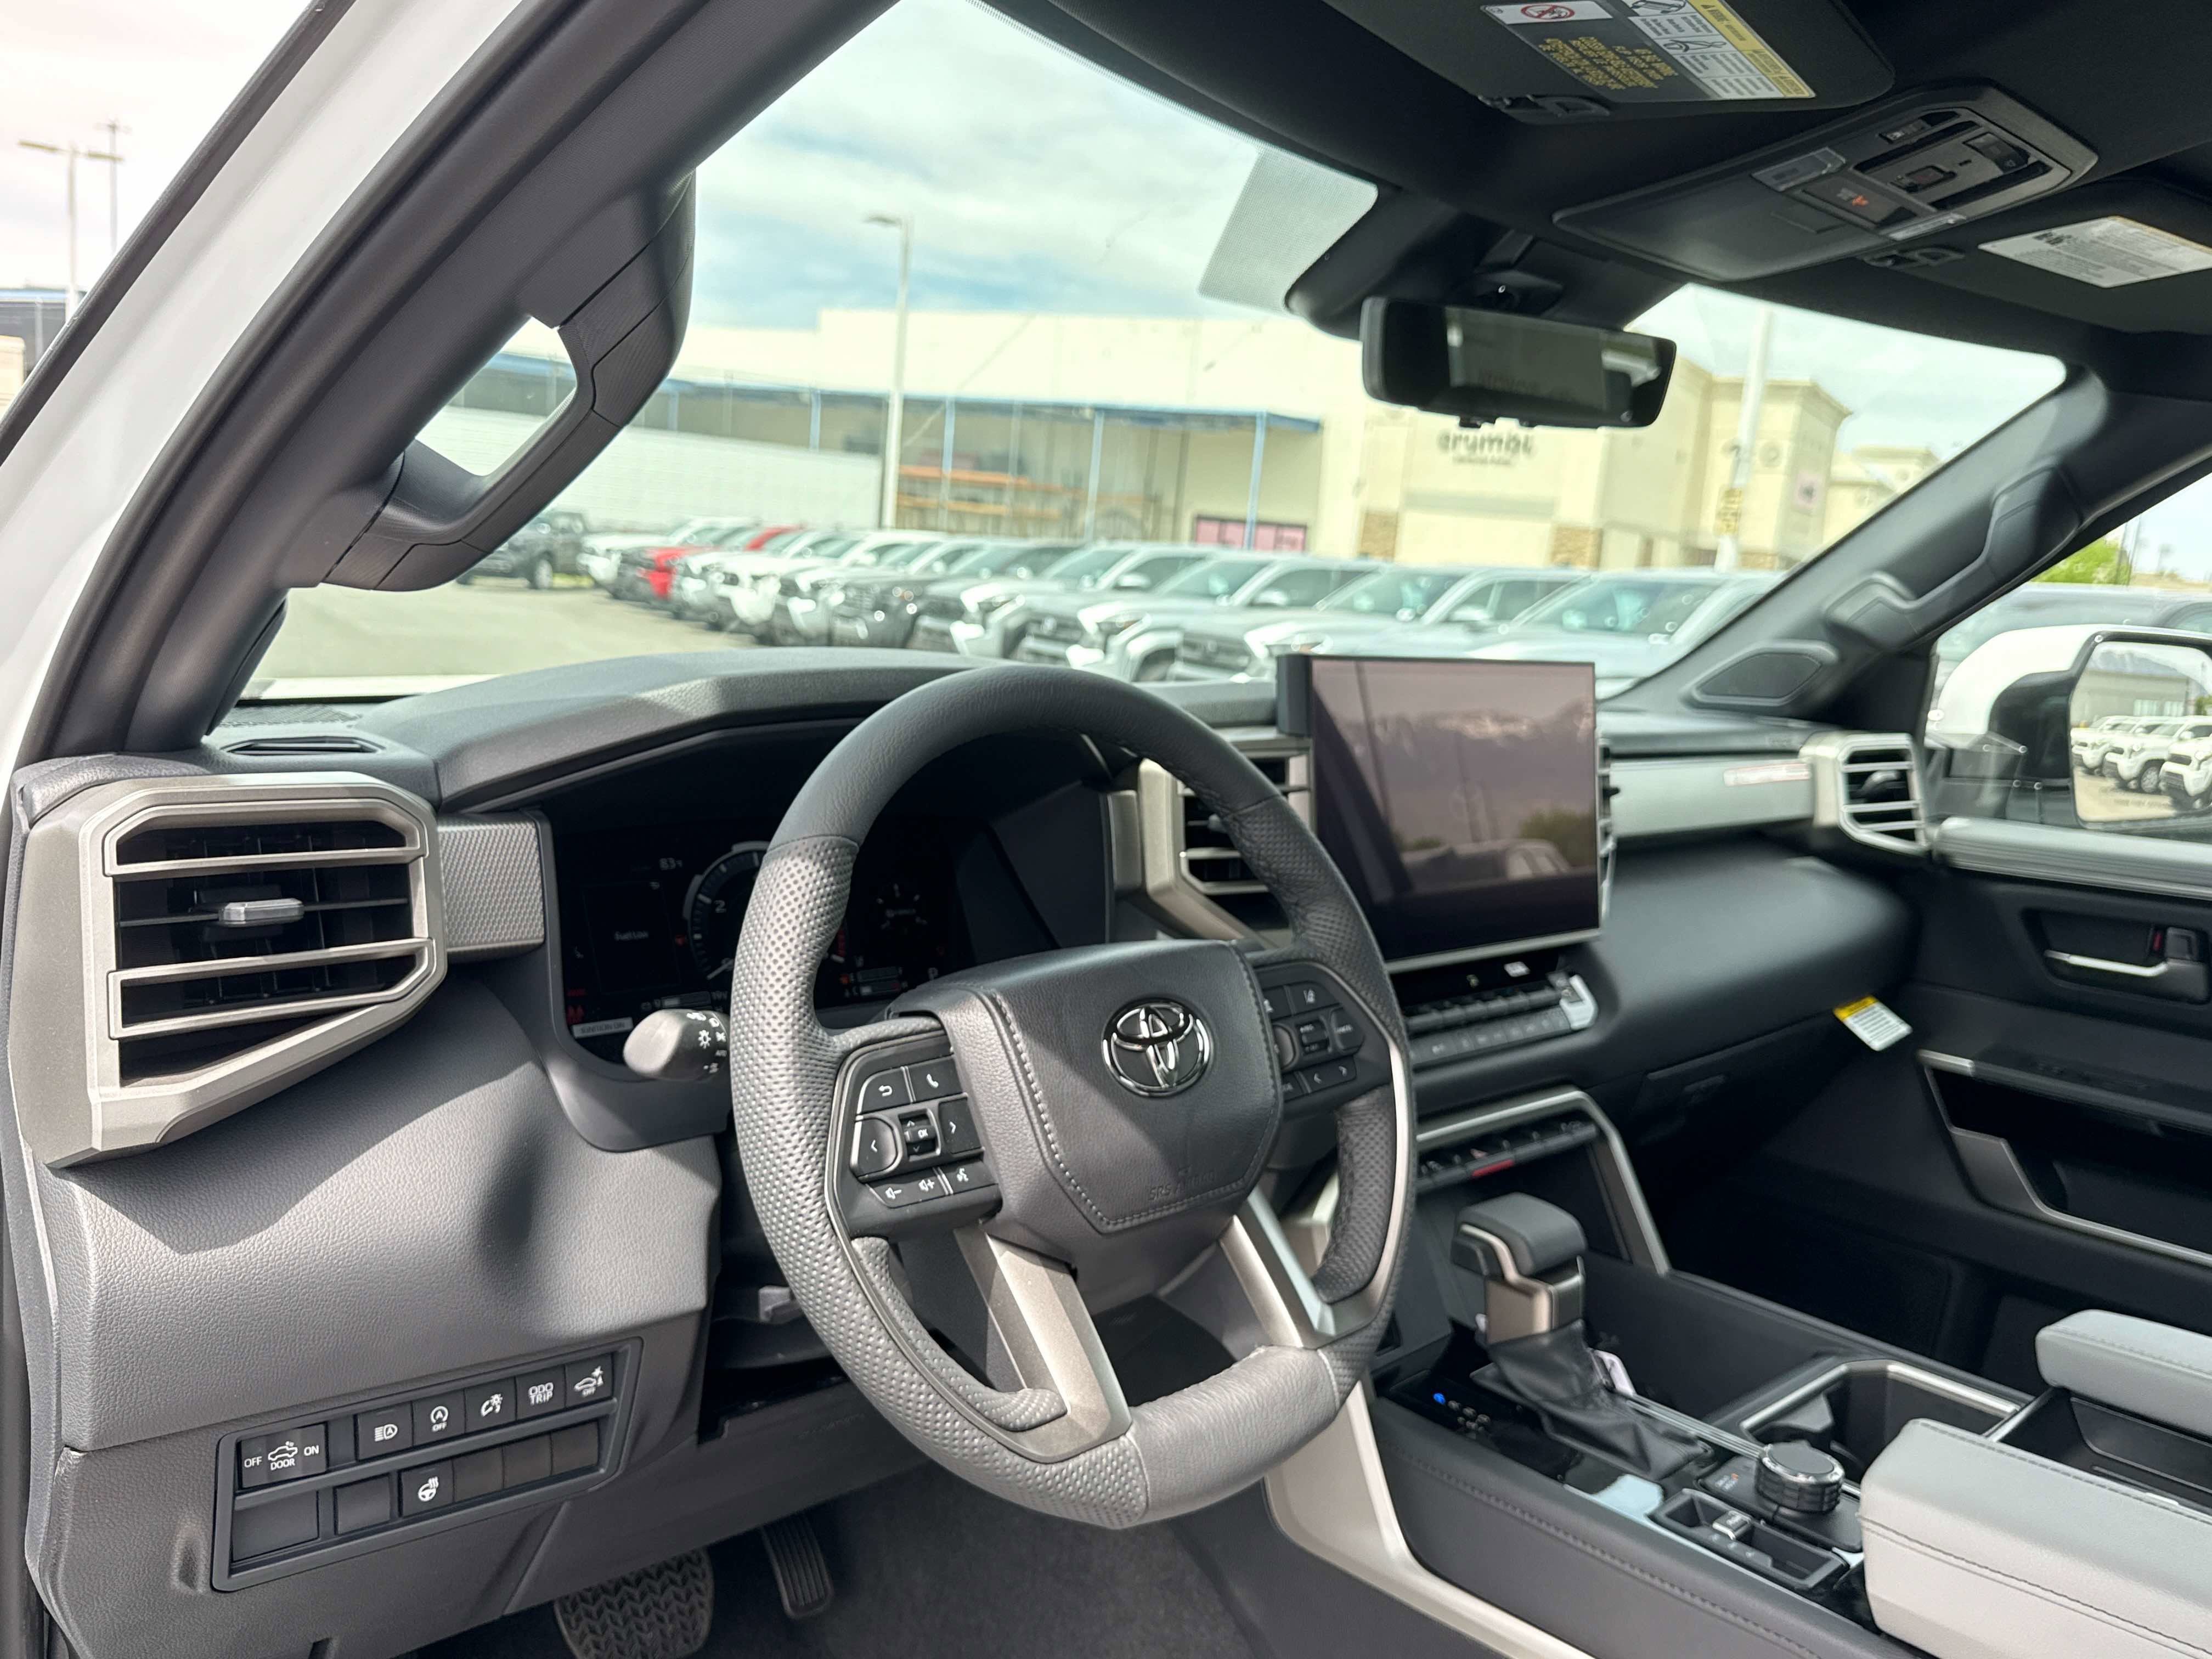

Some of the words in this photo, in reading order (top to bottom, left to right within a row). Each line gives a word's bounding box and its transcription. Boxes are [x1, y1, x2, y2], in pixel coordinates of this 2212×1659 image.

[917, 1128, 928, 1138] OK
[1149, 1184, 1172, 1201] SRS
[528, 1382, 554, 1397] ODO
[529, 1392, 553, 1406] TRIP
[432, 1422, 447, 1432] OFF
[244, 1456, 262, 1468] OFF
[303, 1444, 319, 1456] ON
[270, 1458, 295, 1471] DOOR
